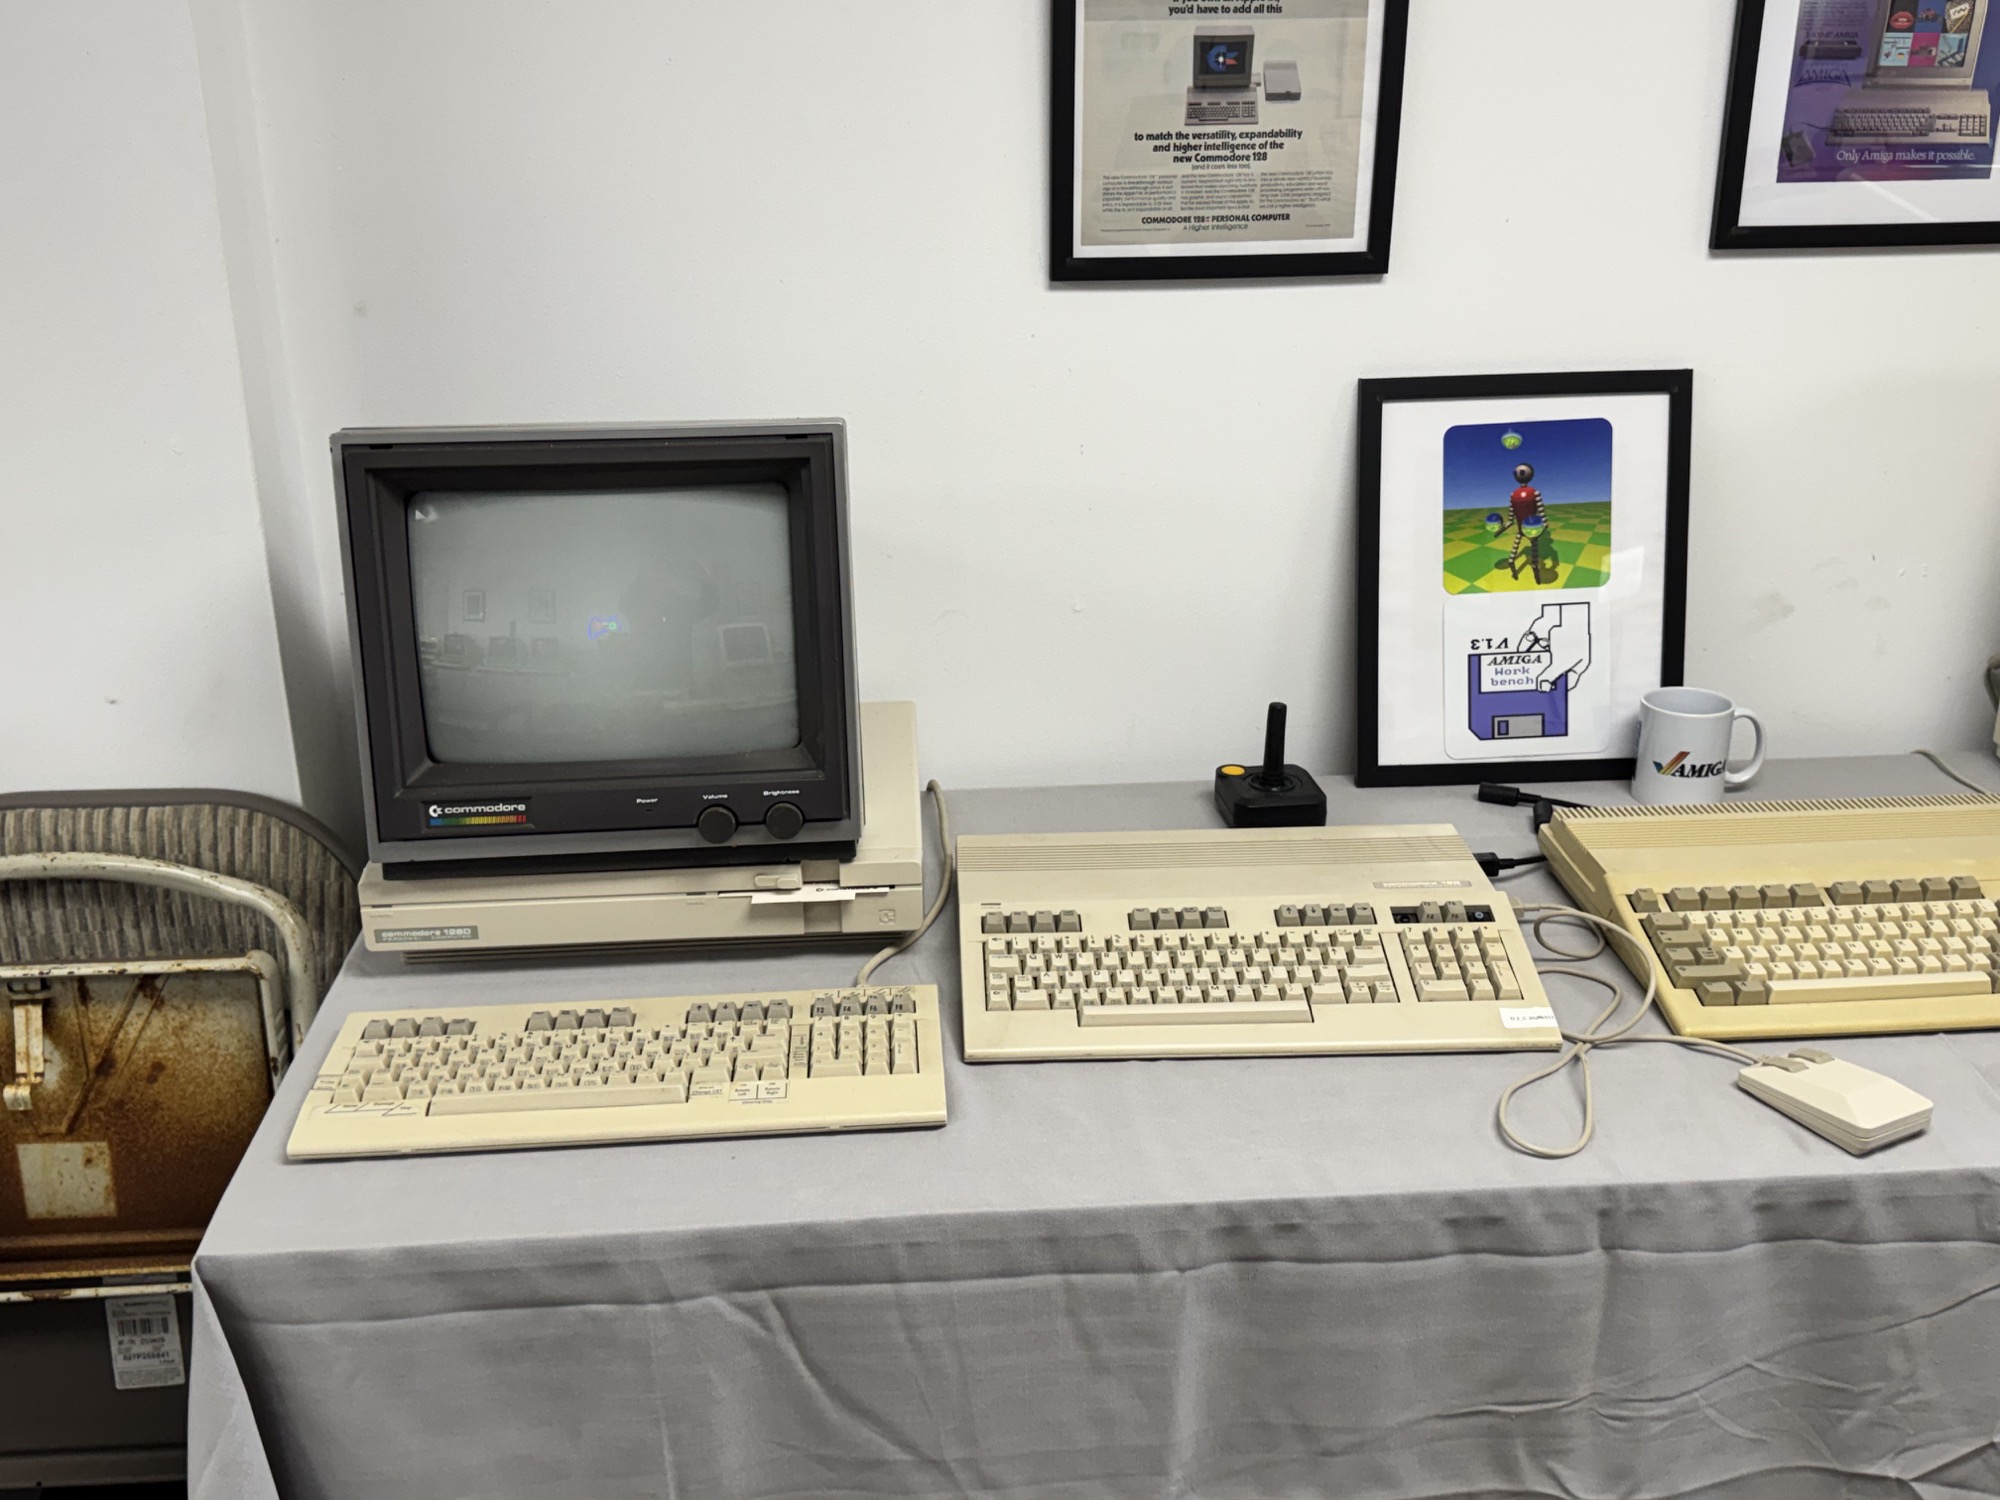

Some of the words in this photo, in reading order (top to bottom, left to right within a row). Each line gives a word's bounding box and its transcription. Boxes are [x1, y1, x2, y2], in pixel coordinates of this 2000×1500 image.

[1168, 4, 1194, 16] you'd
[1197, 4, 1219, 14] have
[1221, 5, 1230, 14] to
[1232, 4, 1251, 14] add
[1253, 4, 1264, 14] all
[1266, 4, 1283, 14] this
[1134, 133, 1144, 141] to
[1146, 131, 1173, 141] match
[1175, 131, 1190, 140] the
[1192, 130, 1237, 142] versatility,
[1239, 129, 1303, 141] expandability
[1153, 143, 1171, 152] and
[1173, 143, 1202, 154] higher
[1204, 141, 1256, 153] intelligence
[1258, 141, 1268, 150] of
[1269, 141, 1284, 149] the
[1173, 155, 1192, 163] new
[1194, 153, 1250, 162] Commodore
[1252, 152, 1268, 161] 128
[1836, 150, 1861, 163] Only
[1862, 150, 1893, 164] Amiga
[1895, 149, 1926, 161] makes
[1928, 150, 1935, 160] it
[1936, 150, 1976, 163] possible.
[1141, 216, 1192, 224] COMMODORE
[1211, 214, 1250, 222] PERSONAL
[1251, 213, 1291, 221] COMPUTER
[1211, 223, 1249, 231] Intelligence
[1487, 655, 1542, 667] AMIGA
[1495, 667, 1530, 676] Work
[1491, 677, 1534, 687] bench
[444, 803, 526, 814] commodore
[382, 929, 440, 938] commodore
[443, 928, 471, 936] 128D
